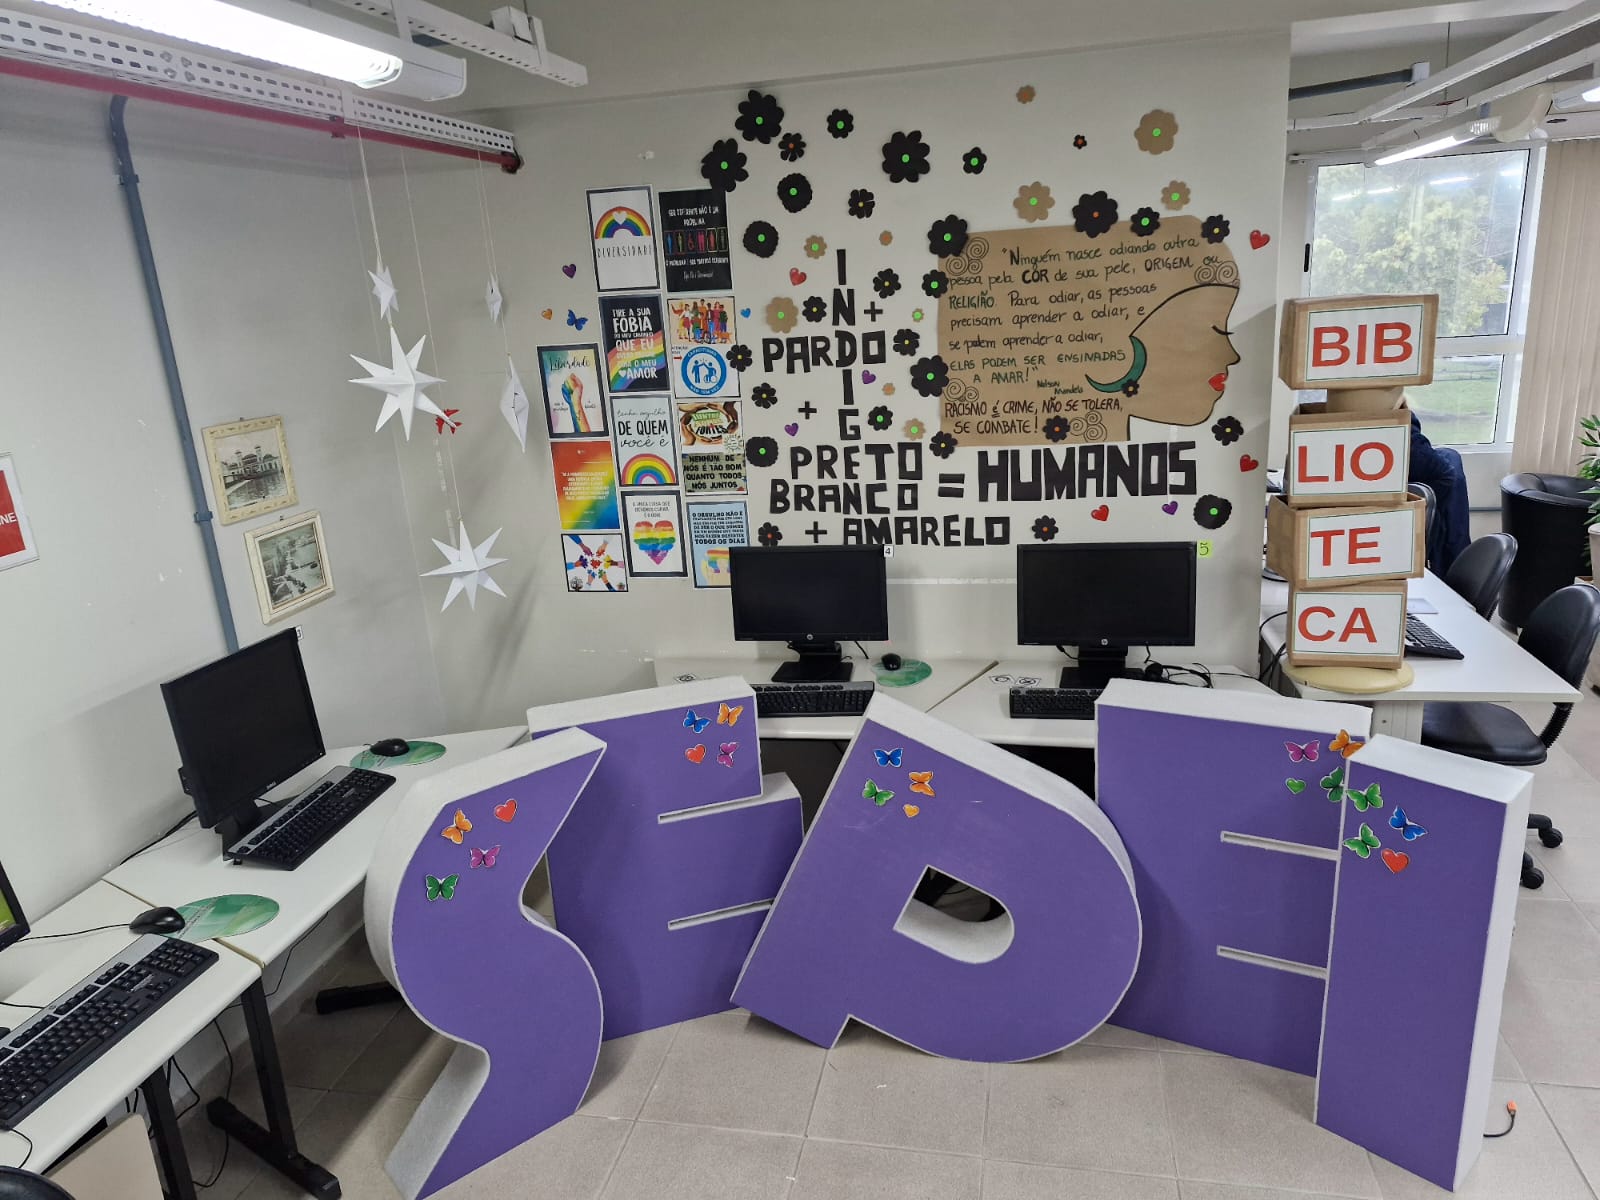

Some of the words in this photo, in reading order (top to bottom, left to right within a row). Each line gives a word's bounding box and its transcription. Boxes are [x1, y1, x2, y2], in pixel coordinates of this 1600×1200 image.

[1067, 246, 1101, 260] nasce
[1109, 241, 1156, 255] odiando
[1163, 235, 1199, 250] outra
[948, 276, 982, 290] pessoa
[988, 271, 1014, 290] pela
[1022, 269, 1049, 284] COR
[1054, 269, 1068, 281] de
[1075, 269, 1099, 279] sua
[1144, 256, 1193, 271] ORIGEM
[1203, 255, 1222, 265] ou
[1008, 290, 1040, 306] Para
[1087, 289, 1102, 300] as
[1109, 283, 1157, 303] pessoas
[636, 307, 651, 316] SUA
[950, 315, 1003, 331] precisam
[1012, 310, 1067, 329] aprender
[1073, 311, 1084, 320] a
[1137, 306, 1145, 315] e
[613, 316, 653, 333] FOBIA
[616, 339, 636, 351] QUE
[641, 338, 655, 350] EU
[762, 330, 887, 374] PARDO
[949, 340, 961, 350] se
[1002, 332, 1053, 350] aprender
[1055, 336, 1063, 344] a
[1312, 322, 1413, 367] BIB
[950, 359, 975, 371] ELAS
[982, 357, 1016, 368] PODEM
[1023, 354, 1046, 365] SER
[1057, 349, 1126, 363] ENSINADAS
[627, 367, 658, 379] AMOR
[973, 374, 981, 383] A
[945, 400, 987, 419] RACISMO
[1042, 396, 1062, 413] NÃO
[1064, 400, 1078, 412] SE
[618, 421, 632, 435] DE
[637, 420, 668, 435] QUEM
[953, 420, 970, 434] SE
[621, 436, 655, 447] você
[660, 436, 669, 447] é
[790, 441, 923, 480] PRETO
[977, 440, 1197, 502] HUMANOS
[1298, 442, 1394, 483] LIO
[686, 473, 715, 481] QUANTO
[710, 481, 738, 489] JUNTOS
[770, 478, 918, 515] BRANCO
[0, 512, 17, 525] NE
[843, 514, 1010, 547] AMARELO
[1311, 526, 1381, 567] TE
[1298, 606, 1377, 644] CA
